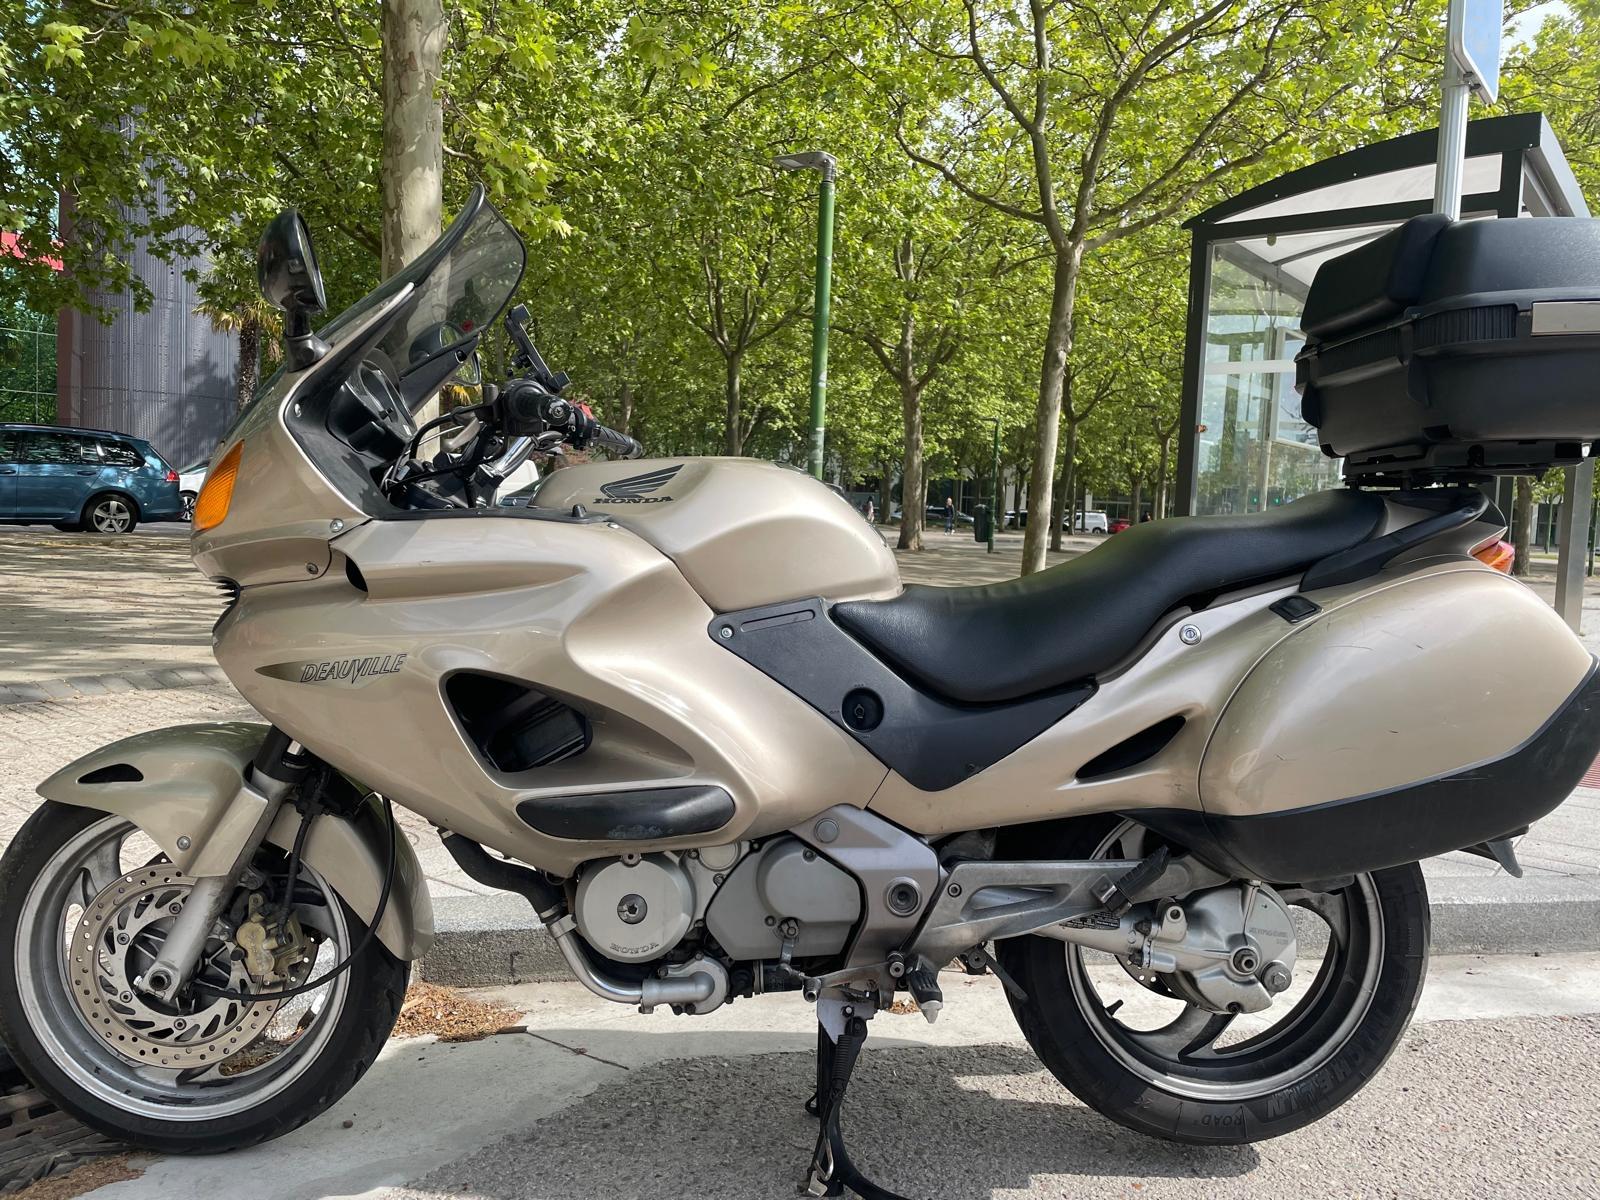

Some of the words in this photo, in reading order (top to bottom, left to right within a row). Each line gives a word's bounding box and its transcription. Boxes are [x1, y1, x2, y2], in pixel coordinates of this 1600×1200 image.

[593, 496, 674, 504] HONDA
[301, 654, 407, 684] DEAUVILLE
[609, 942, 660, 954] HONDA
[1201, 1113, 1242, 1127] ROAD
